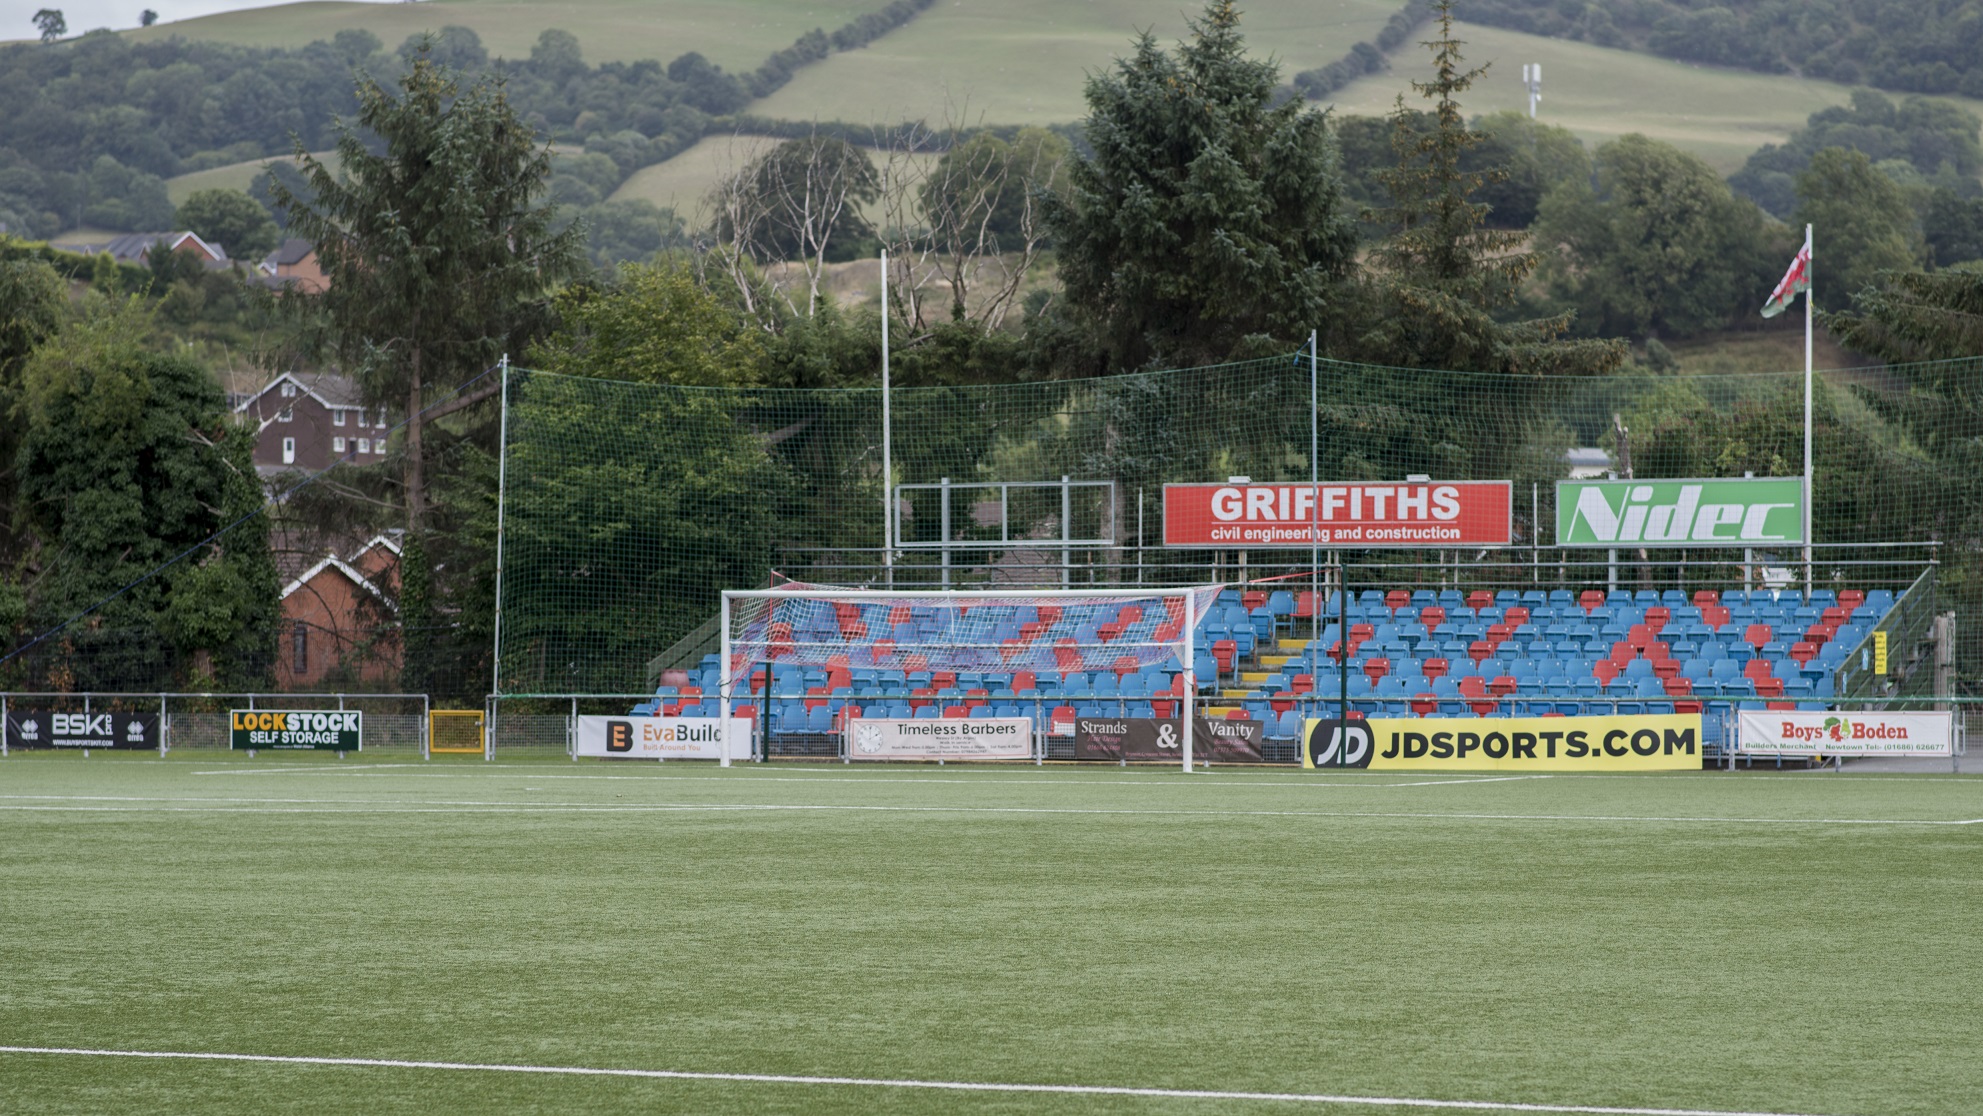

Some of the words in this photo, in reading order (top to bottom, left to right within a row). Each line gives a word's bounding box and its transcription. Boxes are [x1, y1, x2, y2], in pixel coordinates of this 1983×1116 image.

[1211, 486, 1461, 521] GRIFFITHS
[1566, 484, 1796, 542] Nidec
[1211, 526, 1241, 540] civil
[1244, 526, 1330, 542] engineering
[1334, 526, 1362, 540] and
[1366, 526, 1461, 540] construction
[52, 713, 106, 735] BSK
[233, 713, 359, 731] LOCKSTOCK
[898, 723, 957, 735] Timeless
[962, 723, 1017, 735] Barbers
[1781, 721, 1823, 741] Boys
[1851, 723, 1908, 739] Boden
[249, 731, 279, 744] SELF
[281, 731, 340, 744] STORAGE
[1081, 720, 1128, 734] Strands
[1156, 723, 1178, 749] &
[1208, 721, 1254, 740] Vanity
[1381, 728, 1696, 759] JDSPORTS.COM
[1316, 726, 1369, 765] JD
[1745, 742, 1778, 750] Builders
[1884, 743, 1914, 751] (01686)
[1915, 743, 1945, 751] 626677
